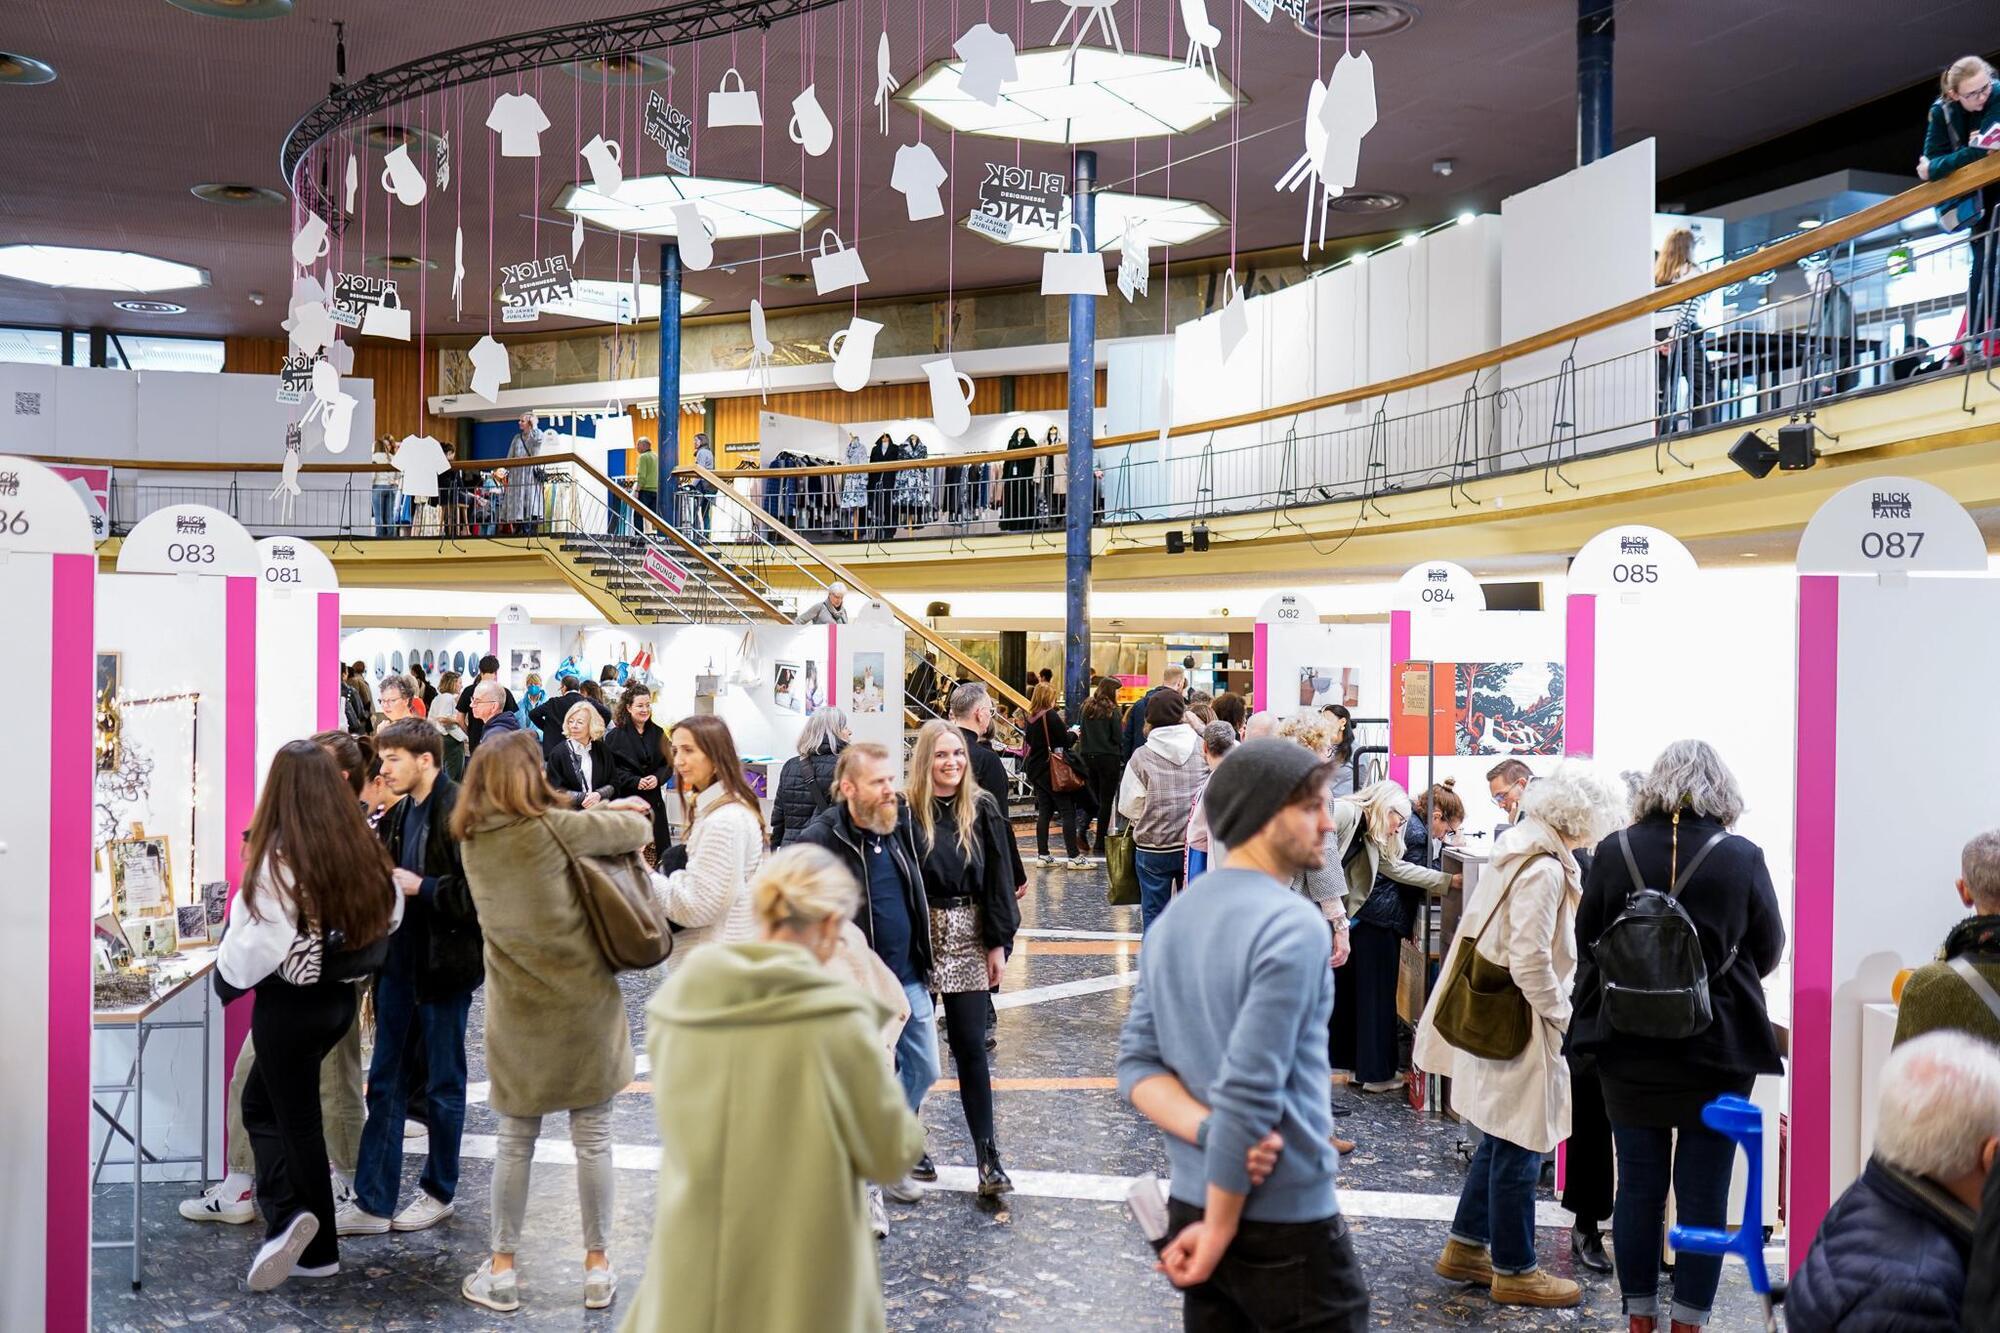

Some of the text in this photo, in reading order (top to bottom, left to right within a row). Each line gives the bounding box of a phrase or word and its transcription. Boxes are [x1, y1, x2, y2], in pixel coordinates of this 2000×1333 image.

[649, 90, 692, 134] BLICK
[645, 122, 687, 158] FANG
[985, 218, 1008, 230] JAHRE
[1872, 492, 1910, 502] BLICK
[177, 515, 205, 524] BLICK
[1872, 508, 1911, 519] FANG
[177, 526, 206, 535] FANG
[1621, 536, 1648, 544] BLICK
[1861, 531, 1925, 559] 087
[168, 543, 215, 563] 083
[1621, 547, 1649, 555] FANG
[266, 567, 301, 583] 081
[652, 560, 677, 582] LOUNGE
[1613, 564, 1659, 583] 085
[1421, 588, 1455, 602] 084
[1278, 608, 1300, 619] 082
